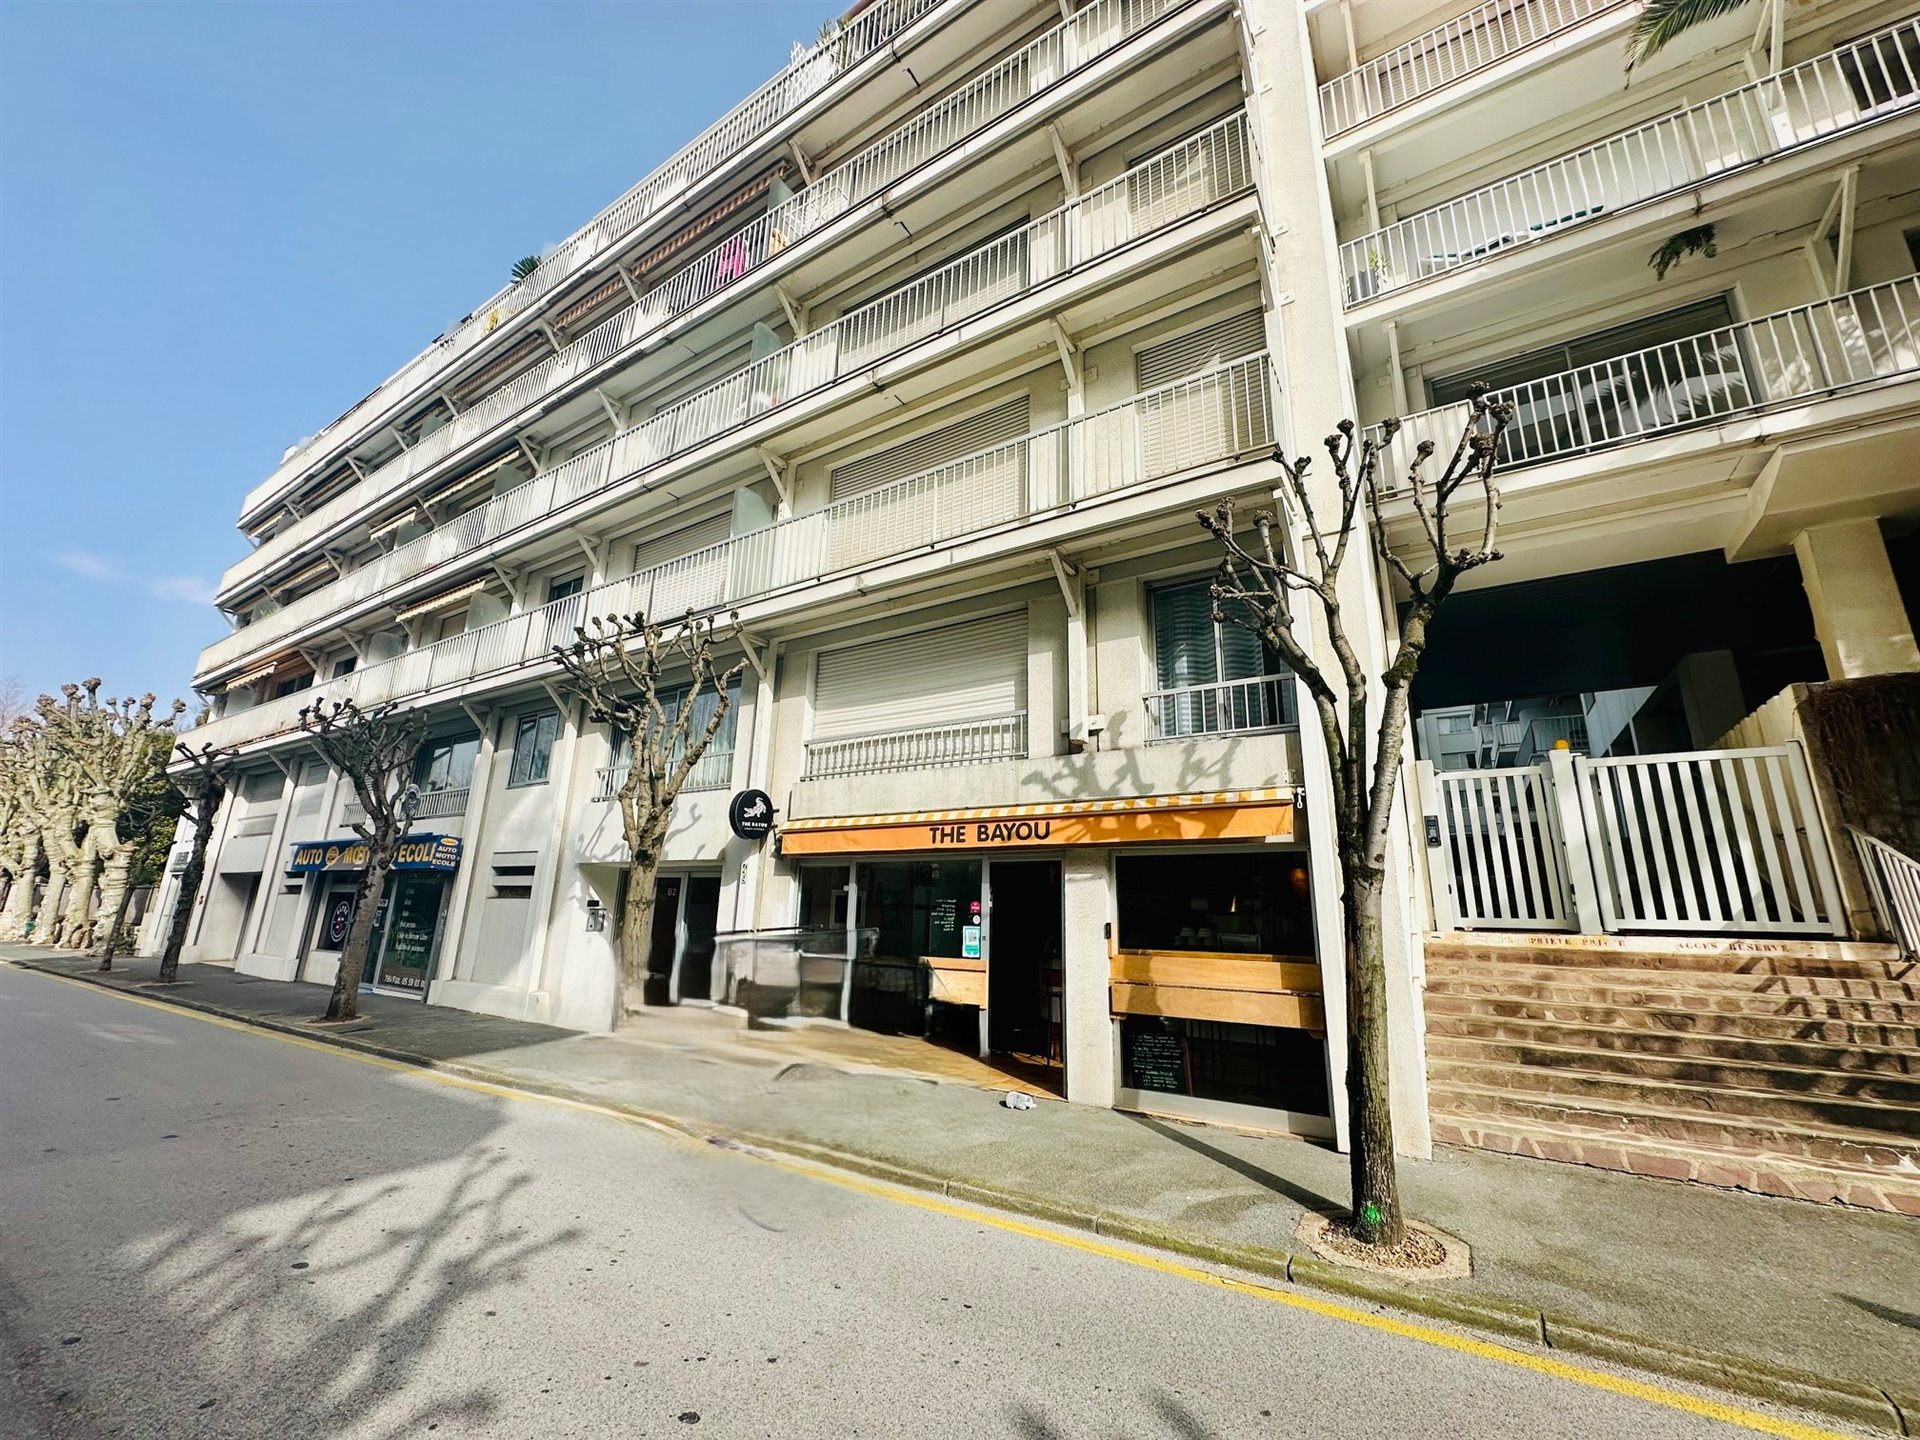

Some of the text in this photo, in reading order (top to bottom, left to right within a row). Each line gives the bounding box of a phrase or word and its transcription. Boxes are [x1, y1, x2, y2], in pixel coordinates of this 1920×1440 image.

[929, 821, 1051, 844] THE BAYOU
[437, 845, 457, 853] AUTO
[294, 849, 322, 865] AUTO
[434, 852, 456, 860] MOTO
[432, 859, 456, 867] ECOLE
